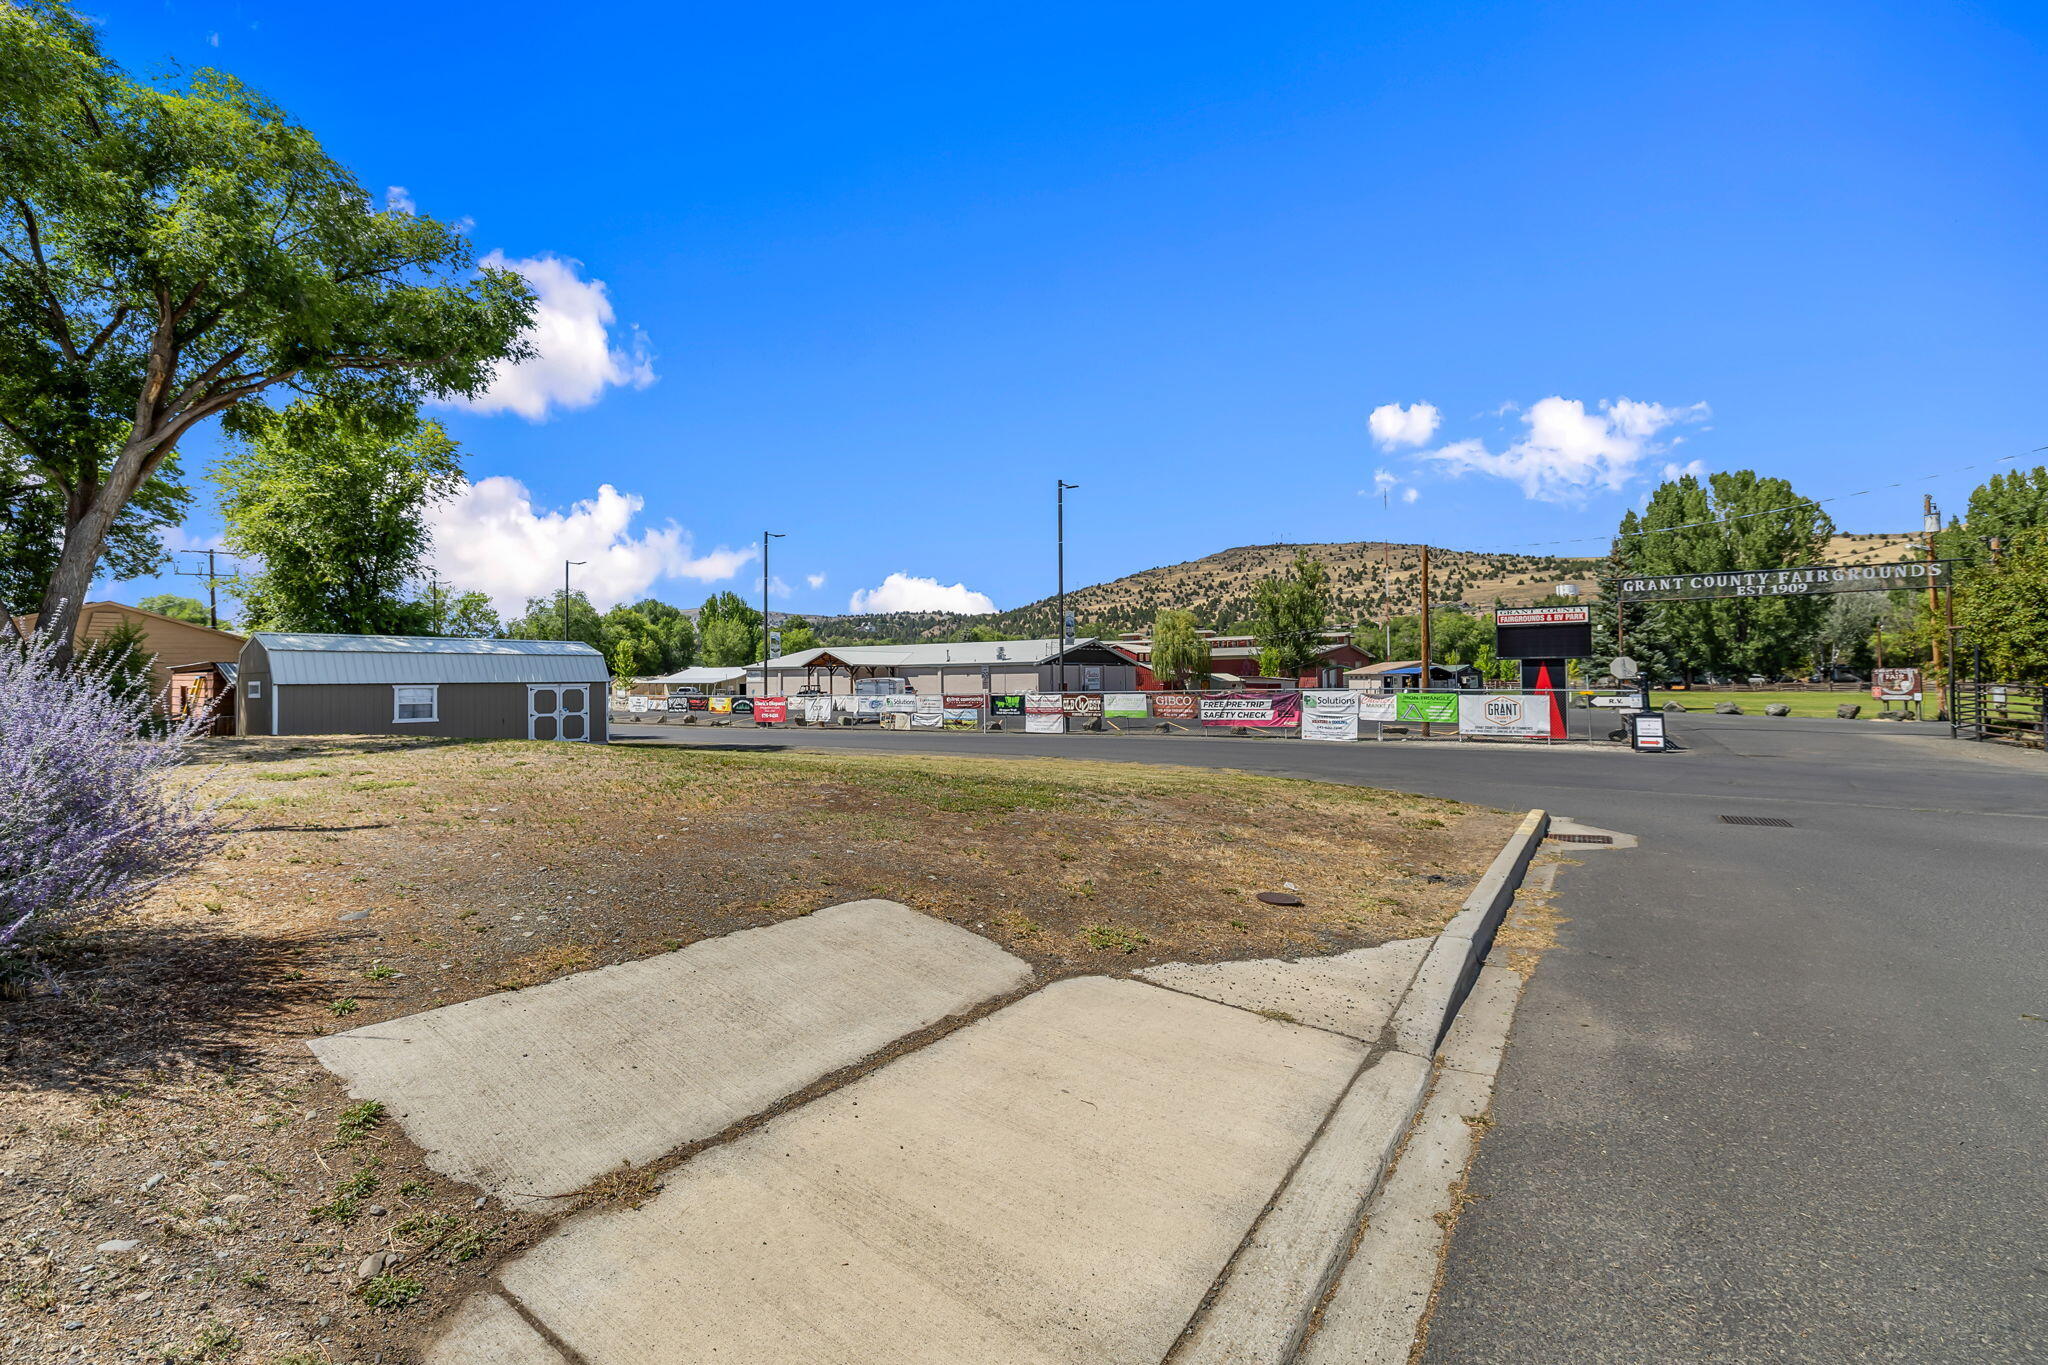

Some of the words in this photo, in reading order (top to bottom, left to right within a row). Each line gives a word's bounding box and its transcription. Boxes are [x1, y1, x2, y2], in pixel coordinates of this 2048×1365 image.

[1623, 577, 1685, 592] GRANT
[1690, 573, 1769, 589] COUNTY
[1778, 563, 1943, 584] FAIRGROUNDS
[1737, 585, 1766, 596] EST
[1770, 583, 1808, 594] 1909
[1500, 614, 1545, 623] FAIRGROUNDS
[1554, 613, 1565, 621] RV
[1565, 612, 1585, 621] PARK
[1063, 699, 1075, 710] OLD
[1156, 695, 1192, 706] GIBCO
[1317, 696, 1356, 705] Solutions
[1203, 711, 1236, 719] SAFETY
[1237, 711, 1267, 719] CHECK
[1487, 703, 1518, 716] GRANT
